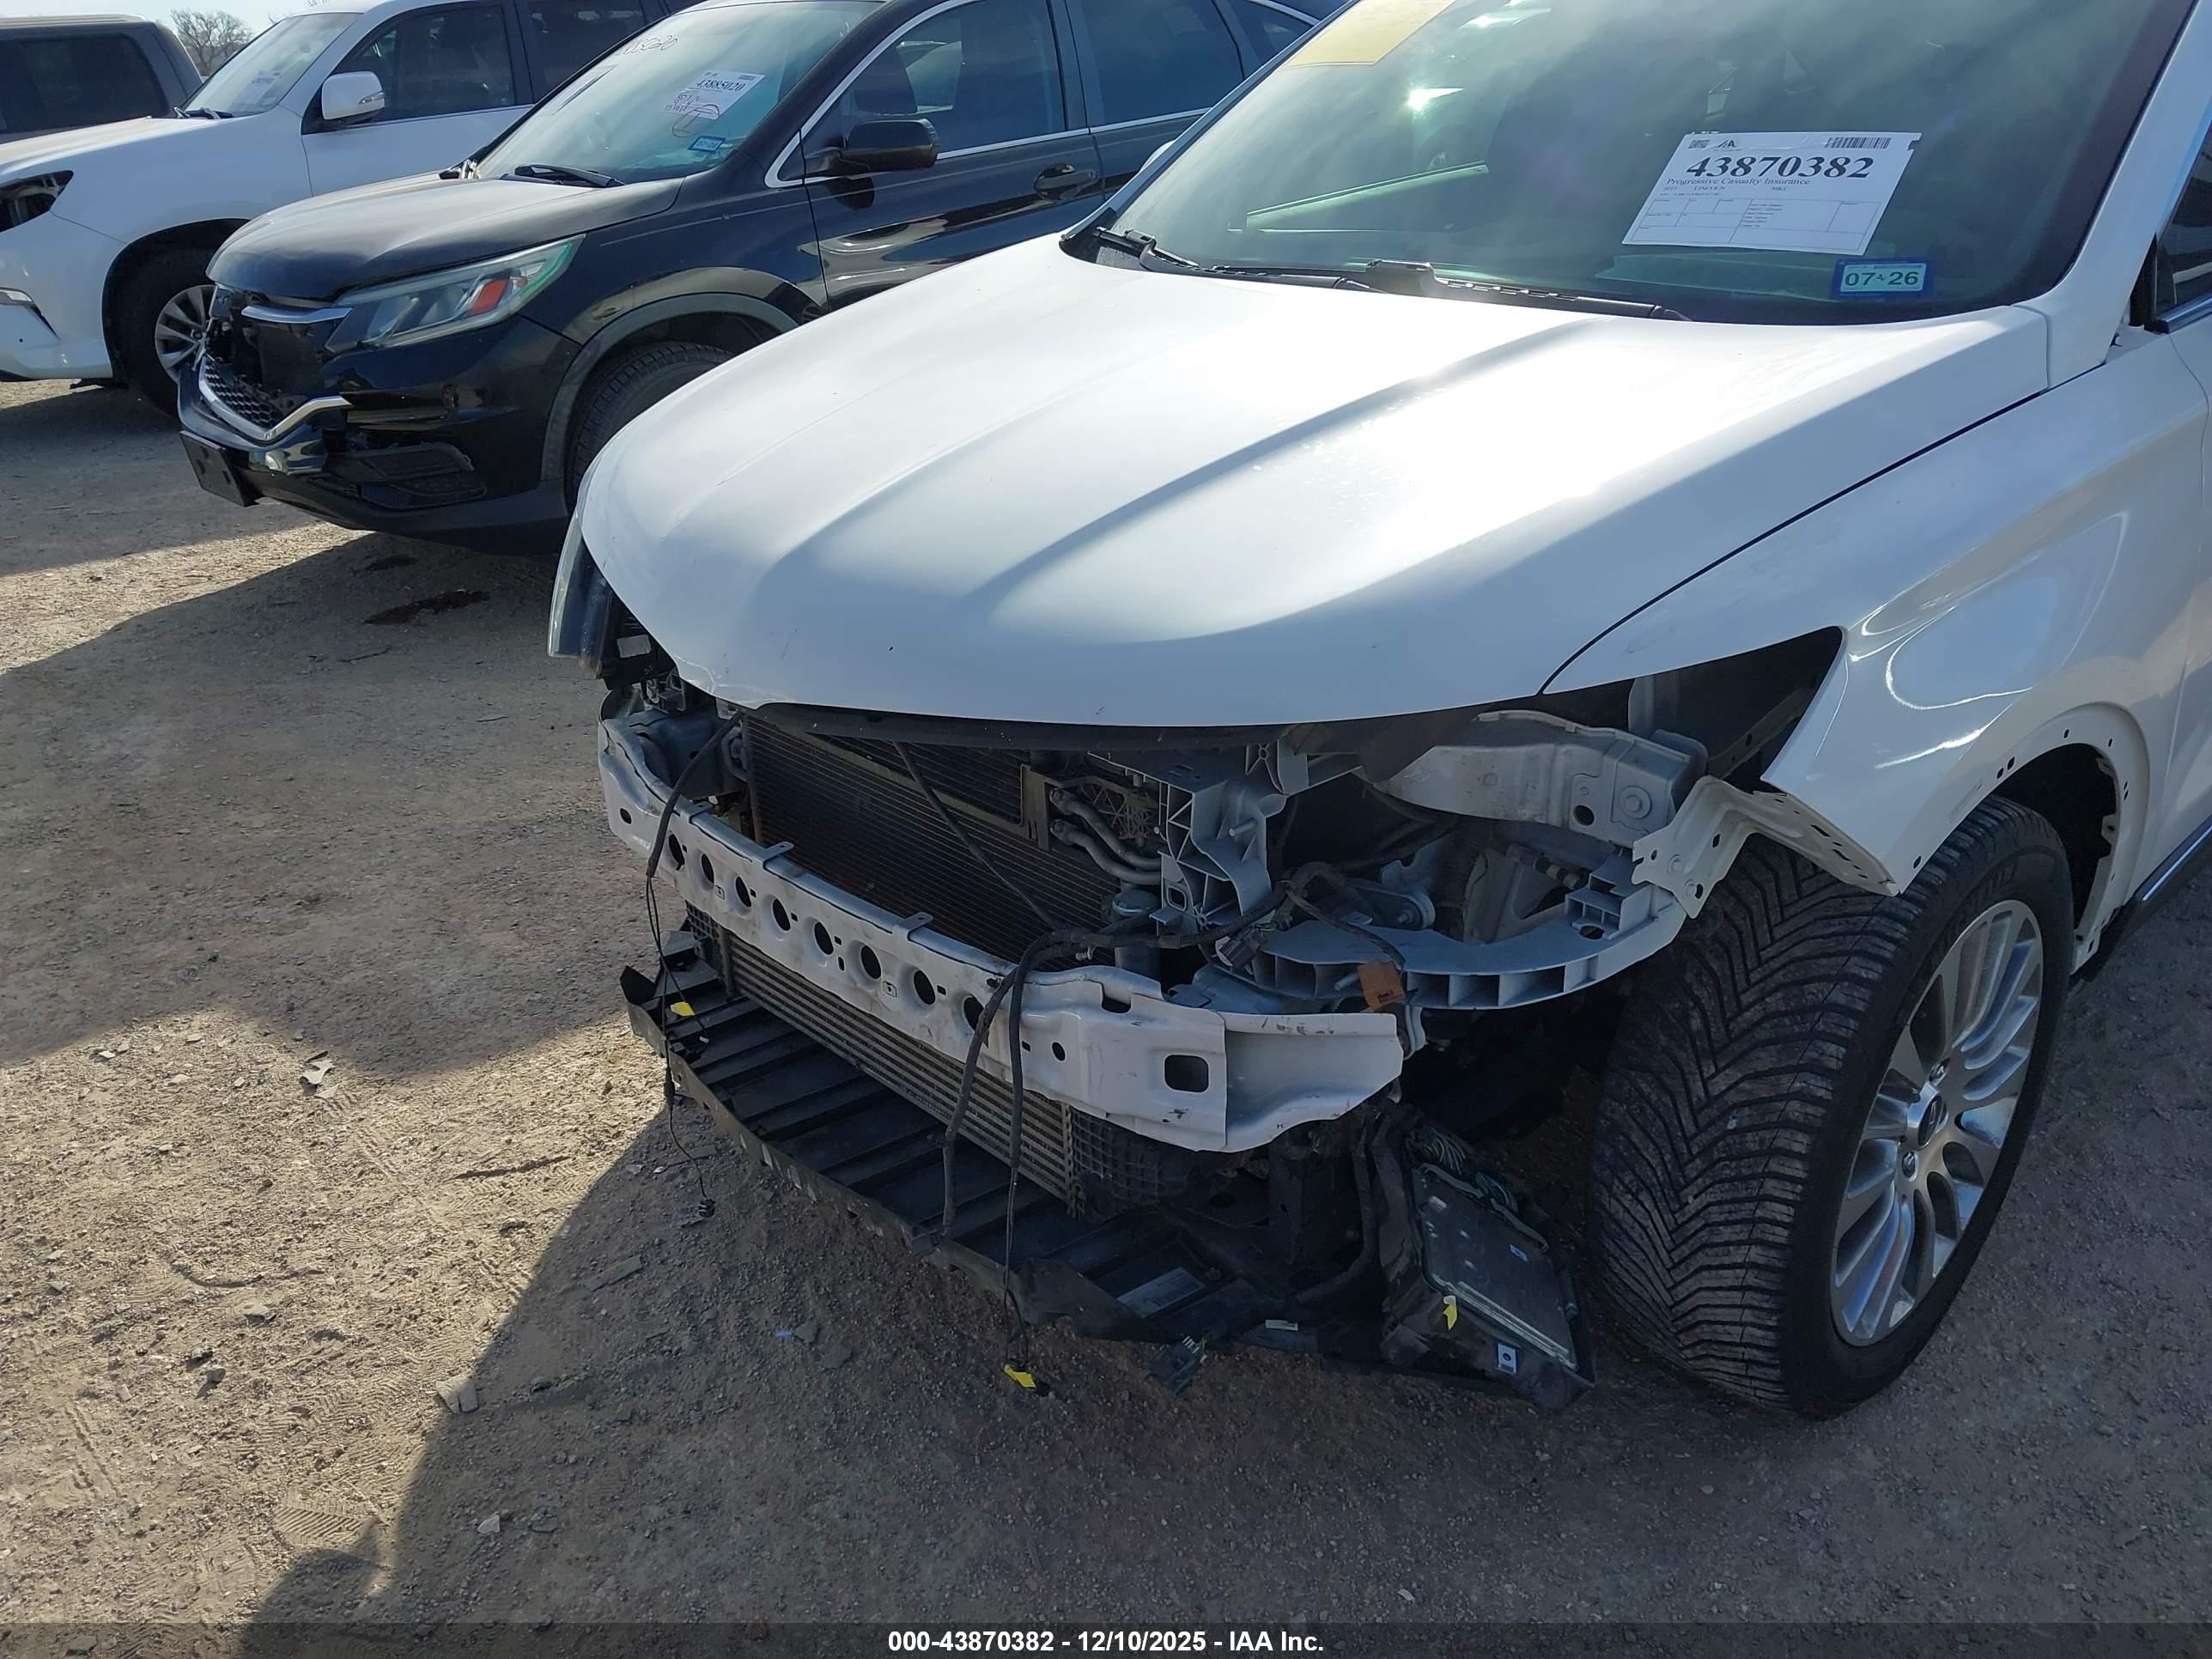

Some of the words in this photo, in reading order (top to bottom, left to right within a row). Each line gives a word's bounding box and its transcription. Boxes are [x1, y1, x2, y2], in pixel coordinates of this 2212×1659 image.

[1686, 155, 1875, 179] 43870382
[1667, 178, 1719, 186] Progressive
[1721, 178, 1761, 186] Casualty
